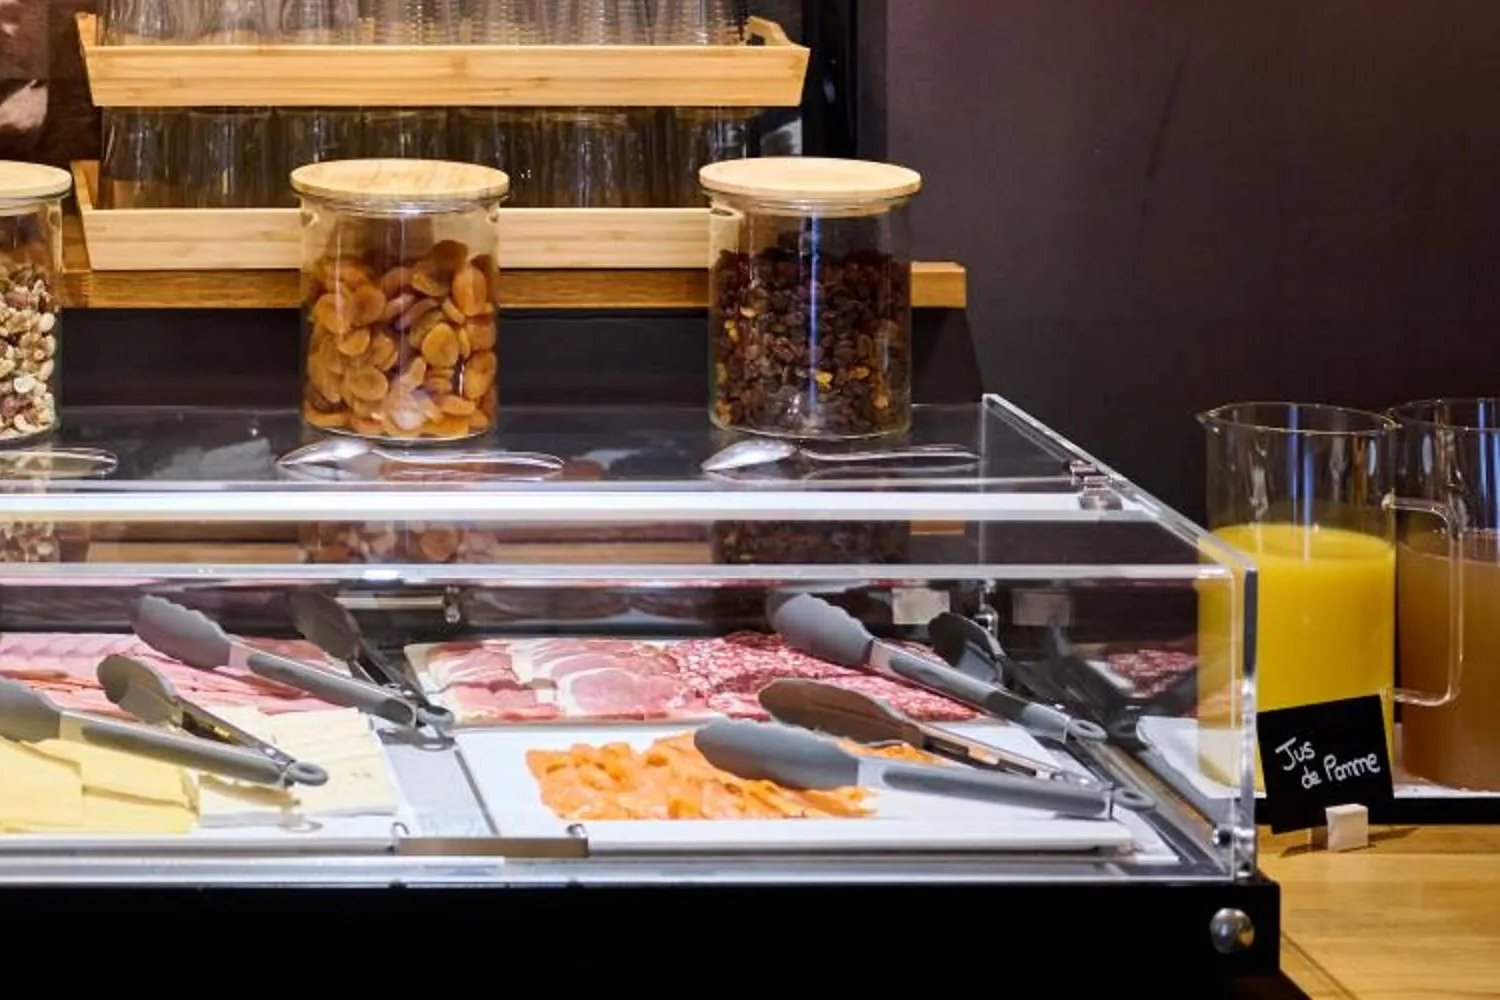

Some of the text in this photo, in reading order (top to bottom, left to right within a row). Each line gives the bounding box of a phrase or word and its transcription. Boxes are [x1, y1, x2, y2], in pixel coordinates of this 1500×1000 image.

[1275, 737, 1315, 771] Jus
[1301, 753, 1381, 790] de Pomme
